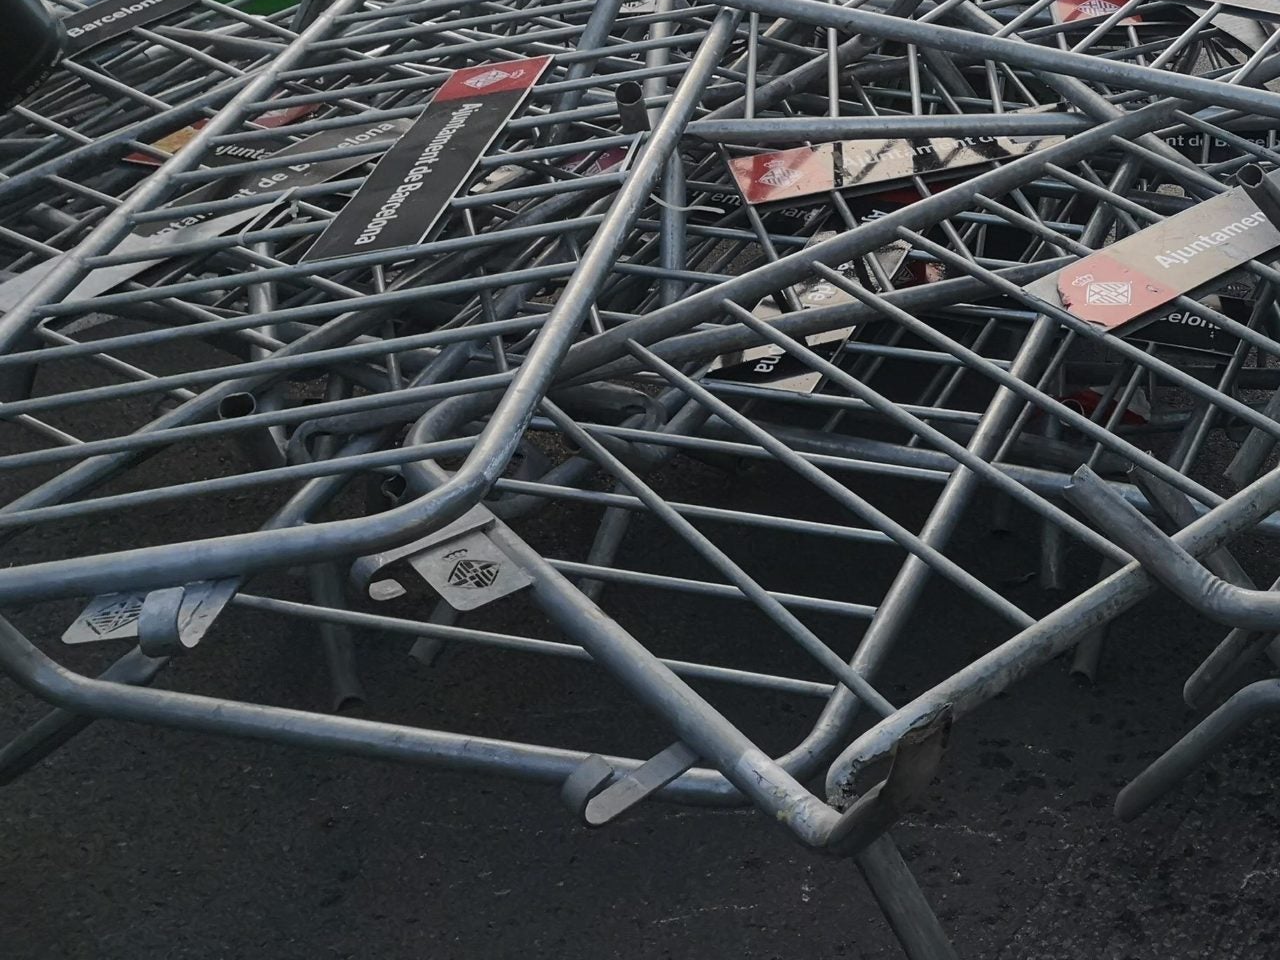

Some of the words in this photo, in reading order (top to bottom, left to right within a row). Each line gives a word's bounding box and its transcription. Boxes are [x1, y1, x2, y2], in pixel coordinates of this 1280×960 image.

[420, 102, 484, 165] Ajuntament
[258, 172, 289, 188] de
[403, 165, 433, 186] de
[354, 182, 424, 246] Barcelona
[1154, 209, 1267, 269] Ajuntamen
